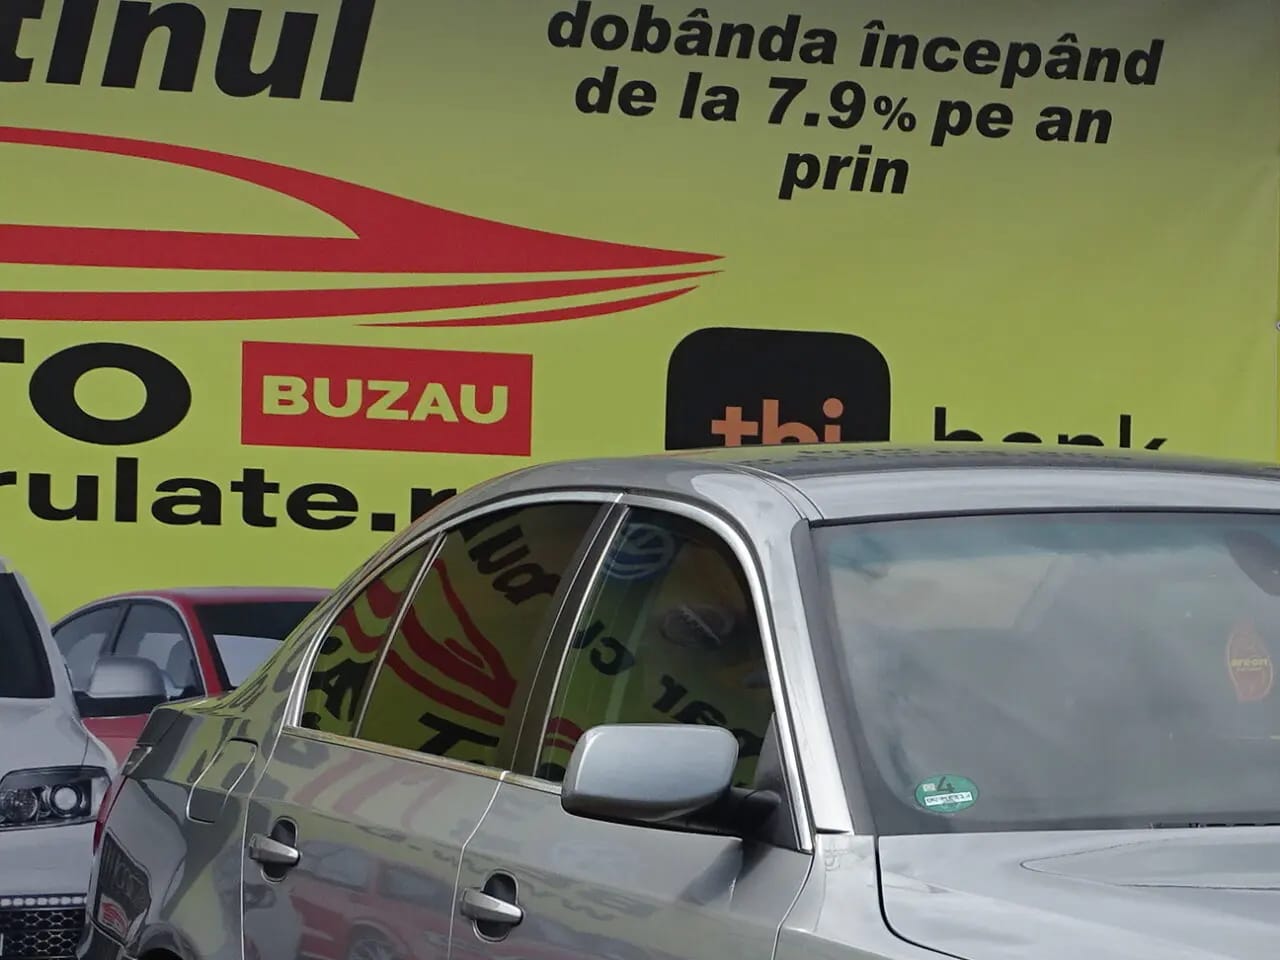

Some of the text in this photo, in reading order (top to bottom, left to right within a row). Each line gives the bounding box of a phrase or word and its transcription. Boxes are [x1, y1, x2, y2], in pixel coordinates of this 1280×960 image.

[548, 0, 1164, 89] dobânda începând
[576, 66, 1112, 147] de la 7.9% pe an
[779, 145, 908, 200] prin
[261, 375, 509, 425] BUZAU
